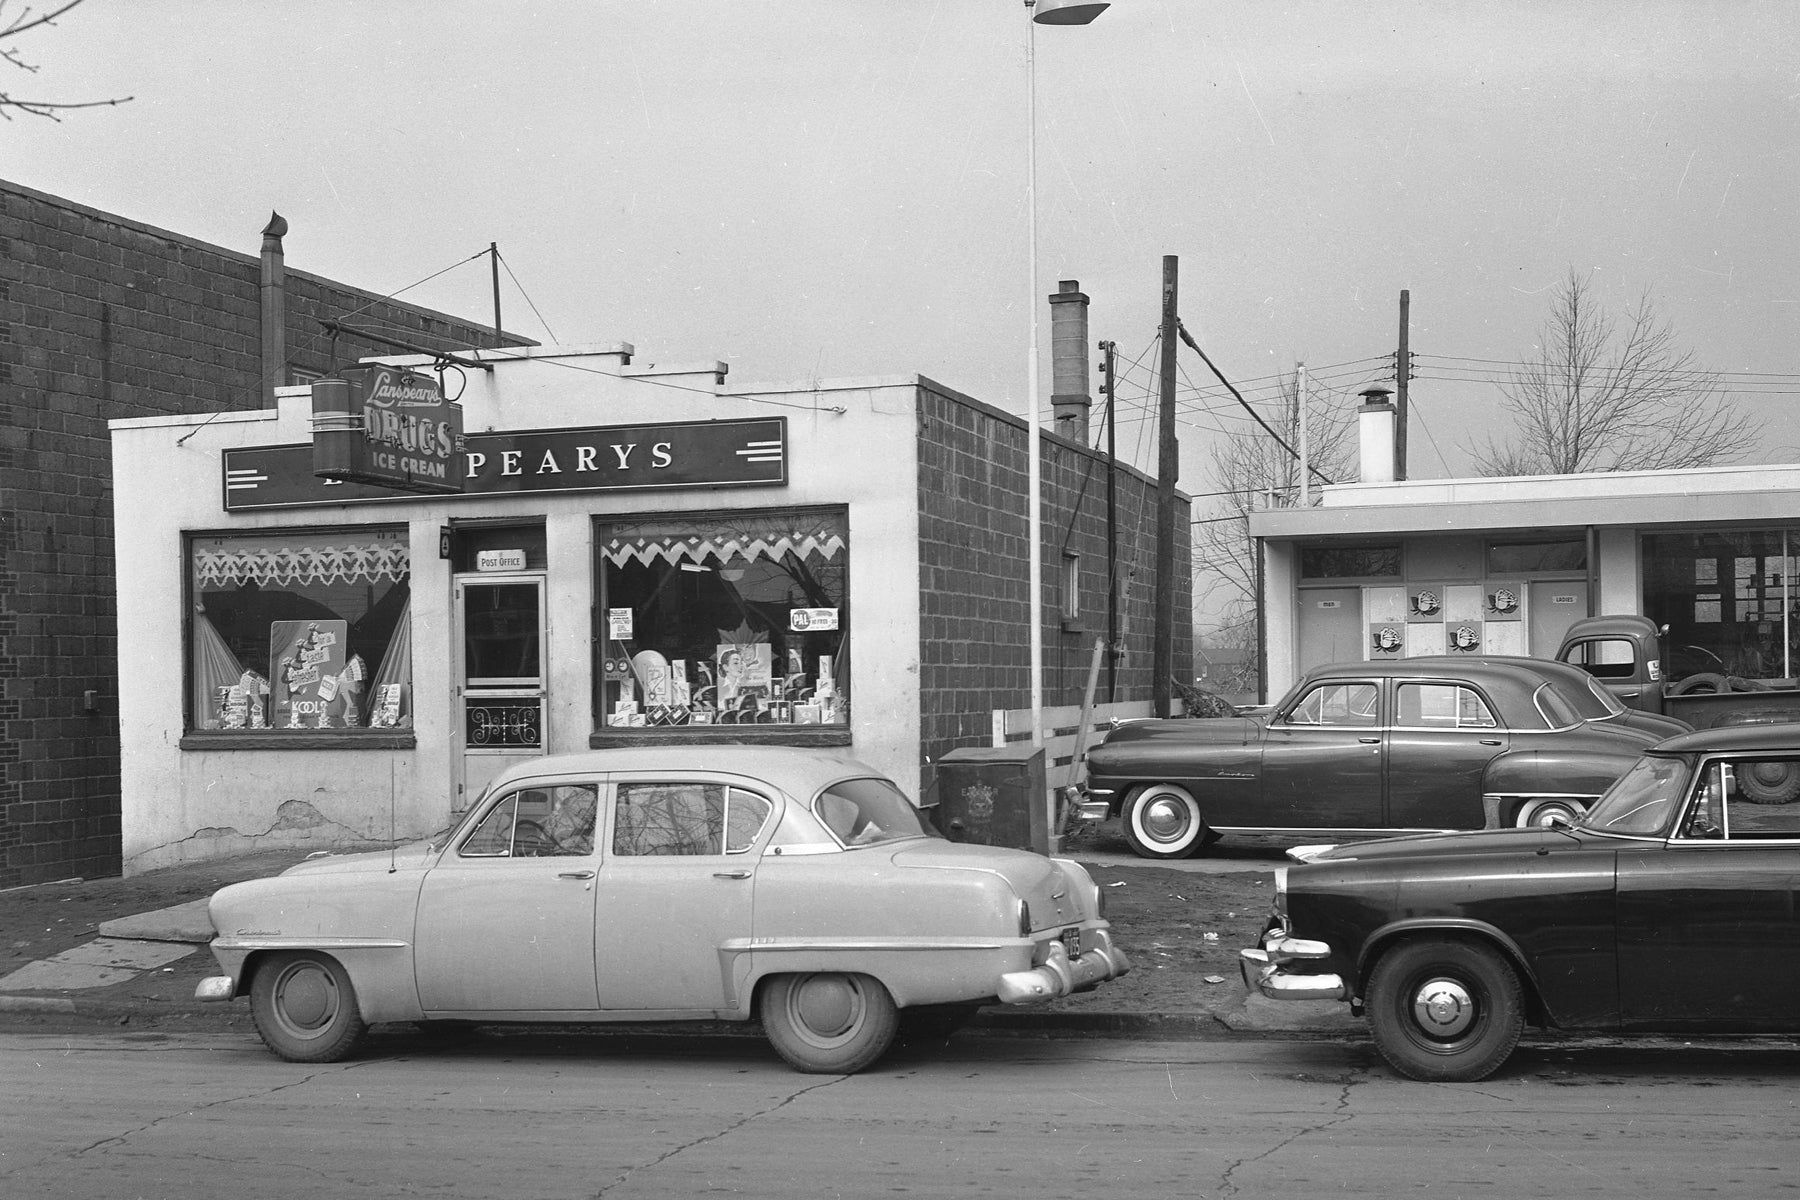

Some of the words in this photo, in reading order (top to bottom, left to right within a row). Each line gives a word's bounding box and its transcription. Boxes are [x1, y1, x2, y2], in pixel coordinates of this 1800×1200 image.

[363, 405, 452, 459] DRUGS
[372, 451, 396, 470] ICE
[400, 456, 446, 479] CREAM
[481, 558, 498, 567] POST
[499, 557, 520, 566] OFFICE
